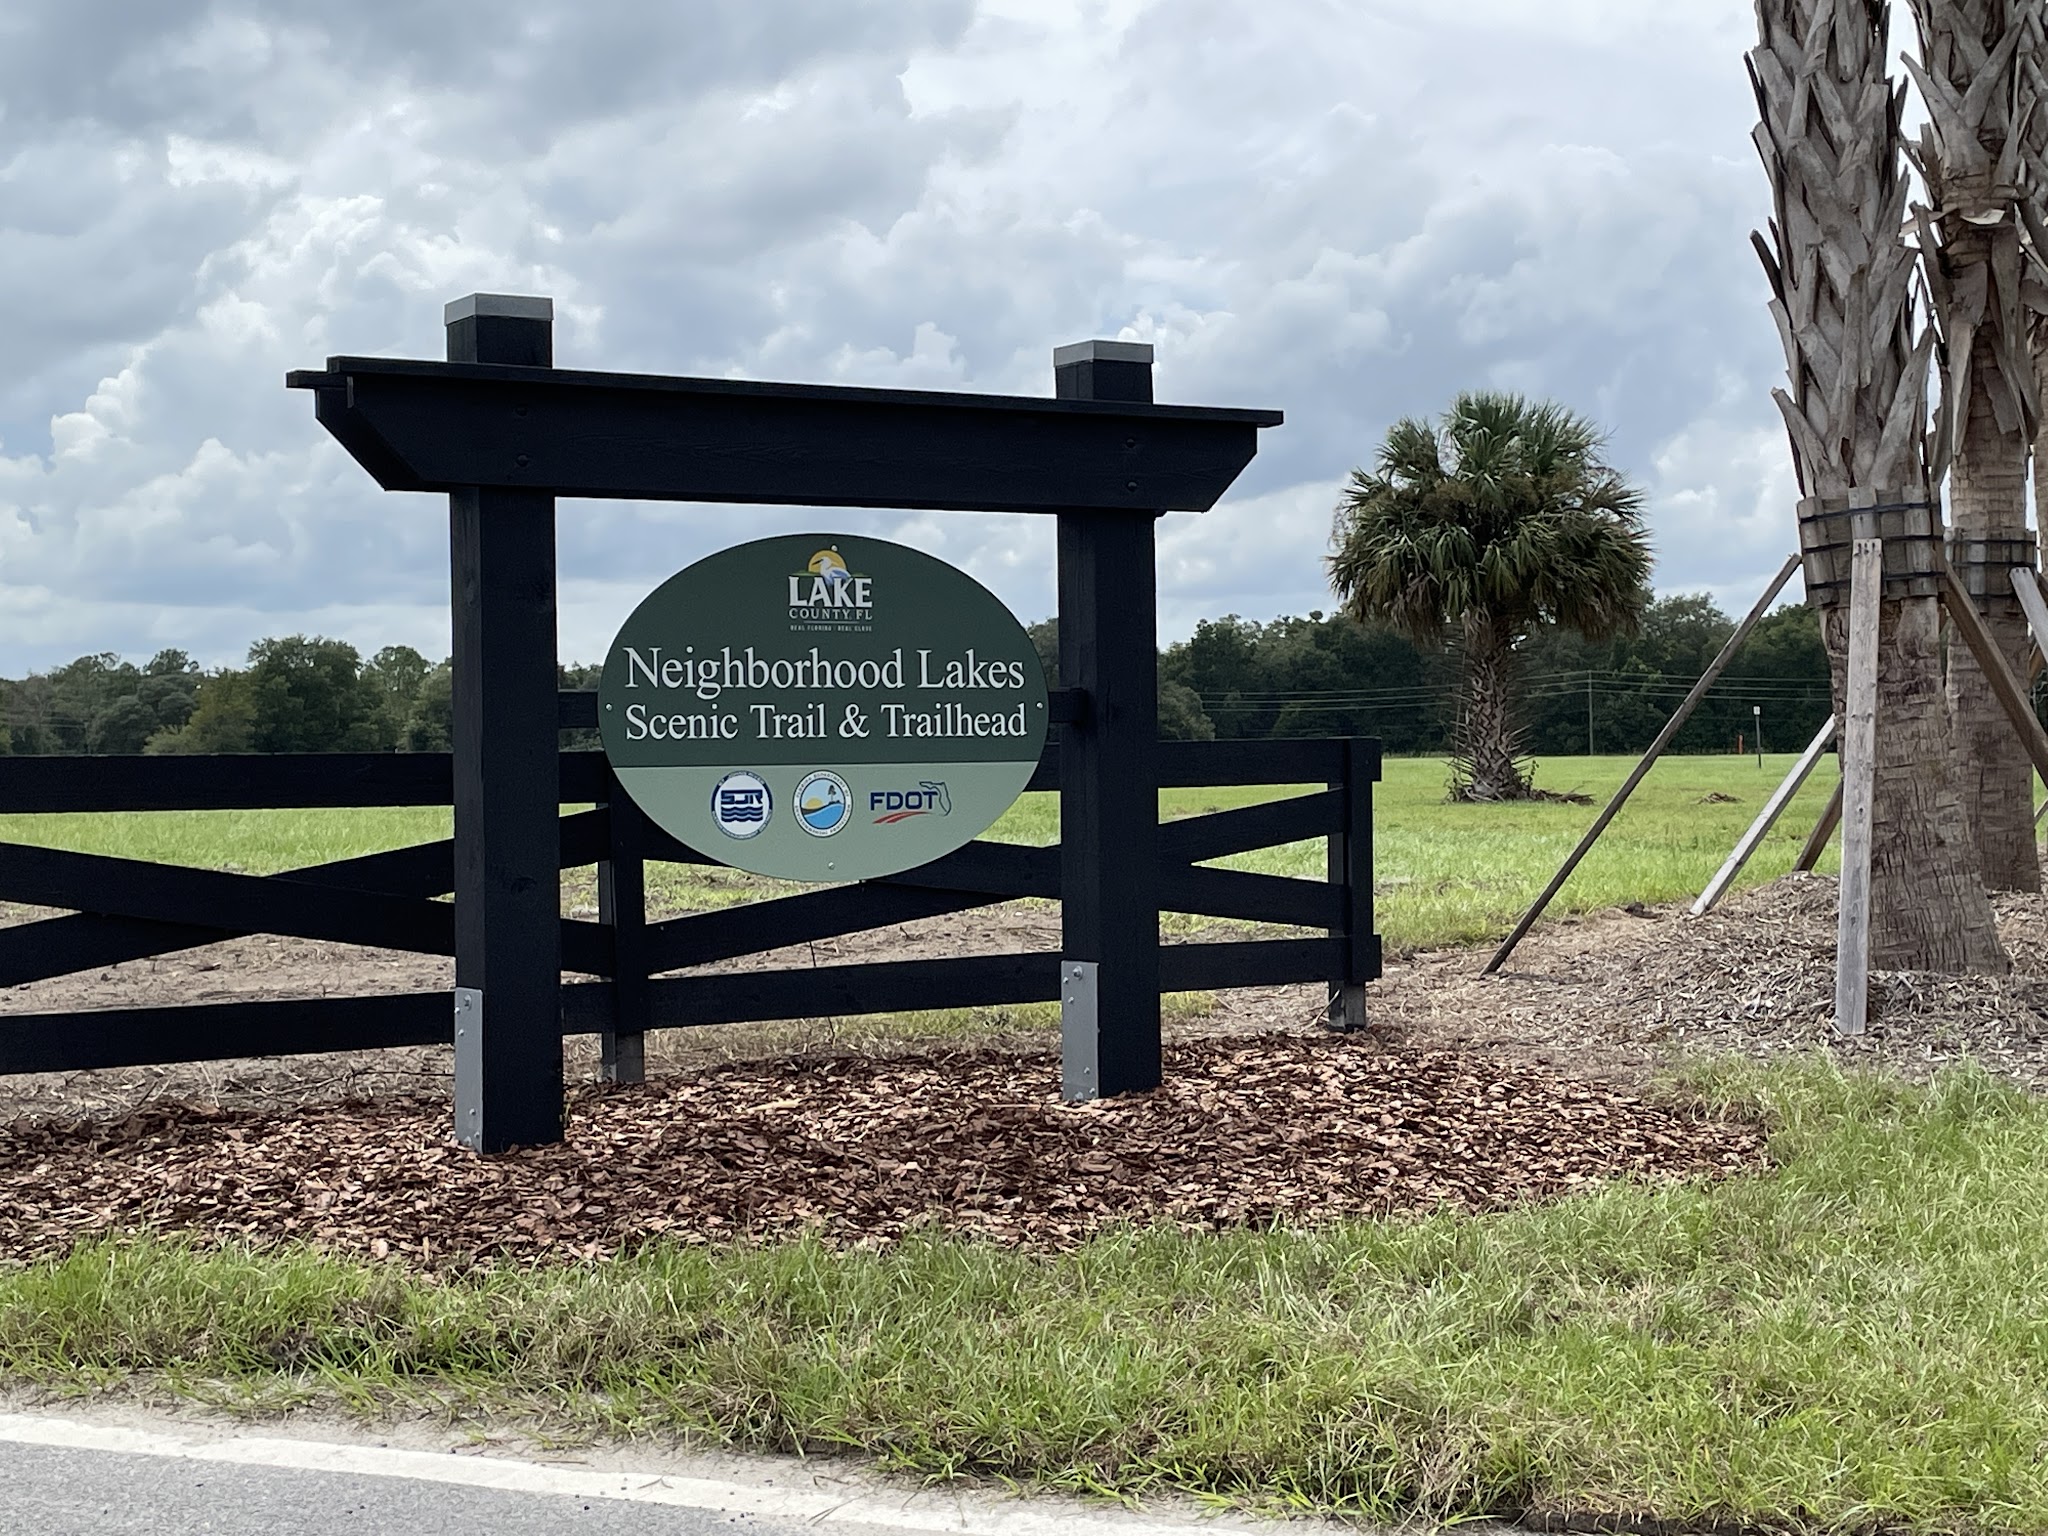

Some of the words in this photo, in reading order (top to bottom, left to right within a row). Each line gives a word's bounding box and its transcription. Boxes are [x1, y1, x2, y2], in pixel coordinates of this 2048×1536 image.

[788, 575, 872, 607] LAKE
[856, 609, 872, 620] FL
[623, 647, 905, 699] Neighborhood
[917, 649, 1024, 688] Lakes
[627, 704, 738, 739] Scenic
[750, 704, 827, 738] Trail
[839, 704, 869, 737] &
[881, 703, 1027, 736] Trailhead
[870, 791, 937, 810] FDOT
